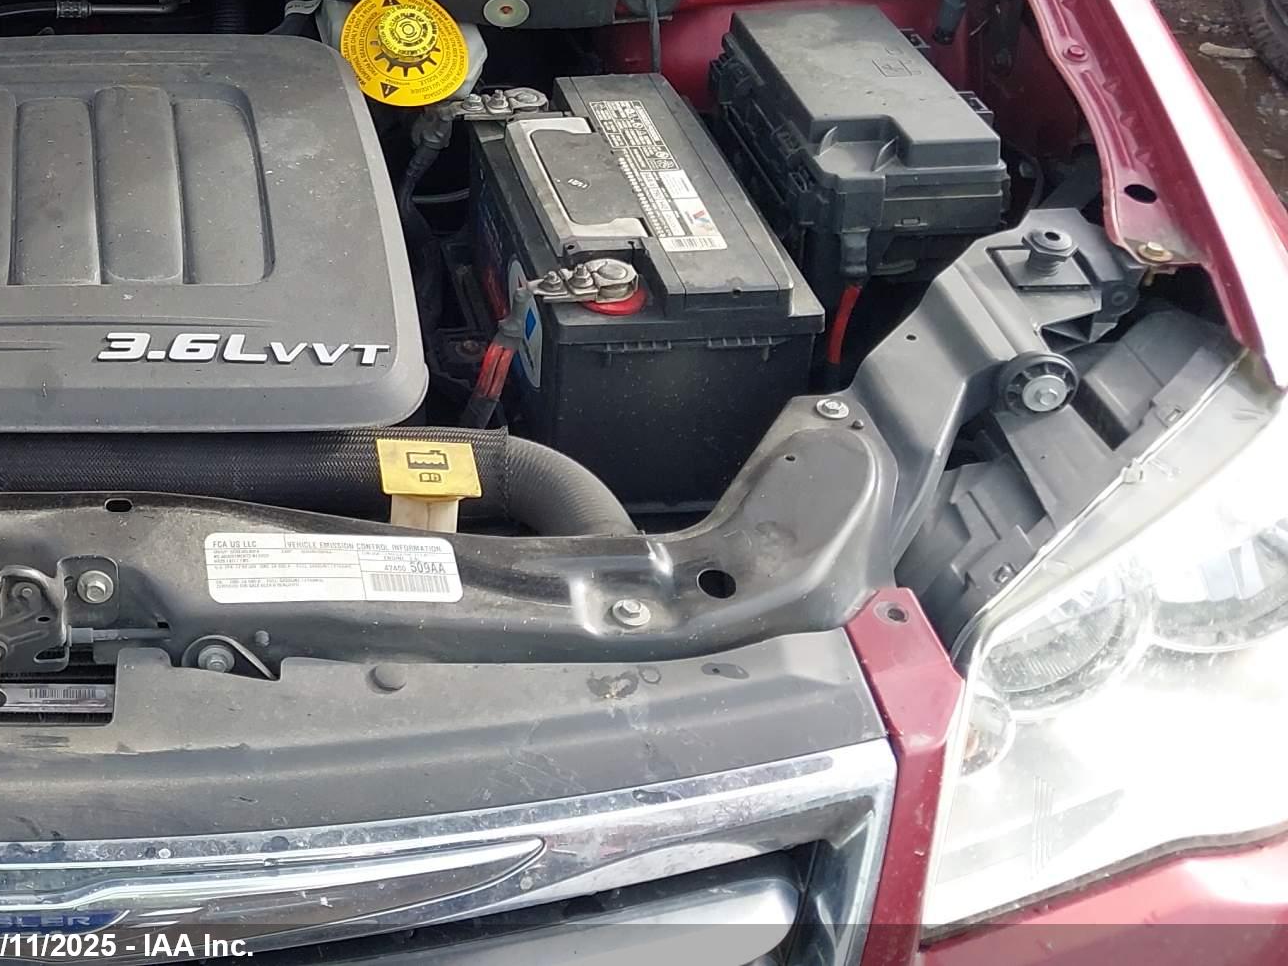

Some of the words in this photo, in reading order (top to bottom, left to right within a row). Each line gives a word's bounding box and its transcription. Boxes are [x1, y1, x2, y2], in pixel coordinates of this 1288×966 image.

[96, 332, 268, 363] 3.6L
[269, 342, 390, 365] VVT
[213, 540, 227, 548] FCA
[230, 540, 241, 548] US
[243, 540, 257, 548] LLC
[287, 541, 316, 549] VEHICLE
[356, 543, 389, 551] CONTROL
[392, 544, 442, 552] INFORMATION
